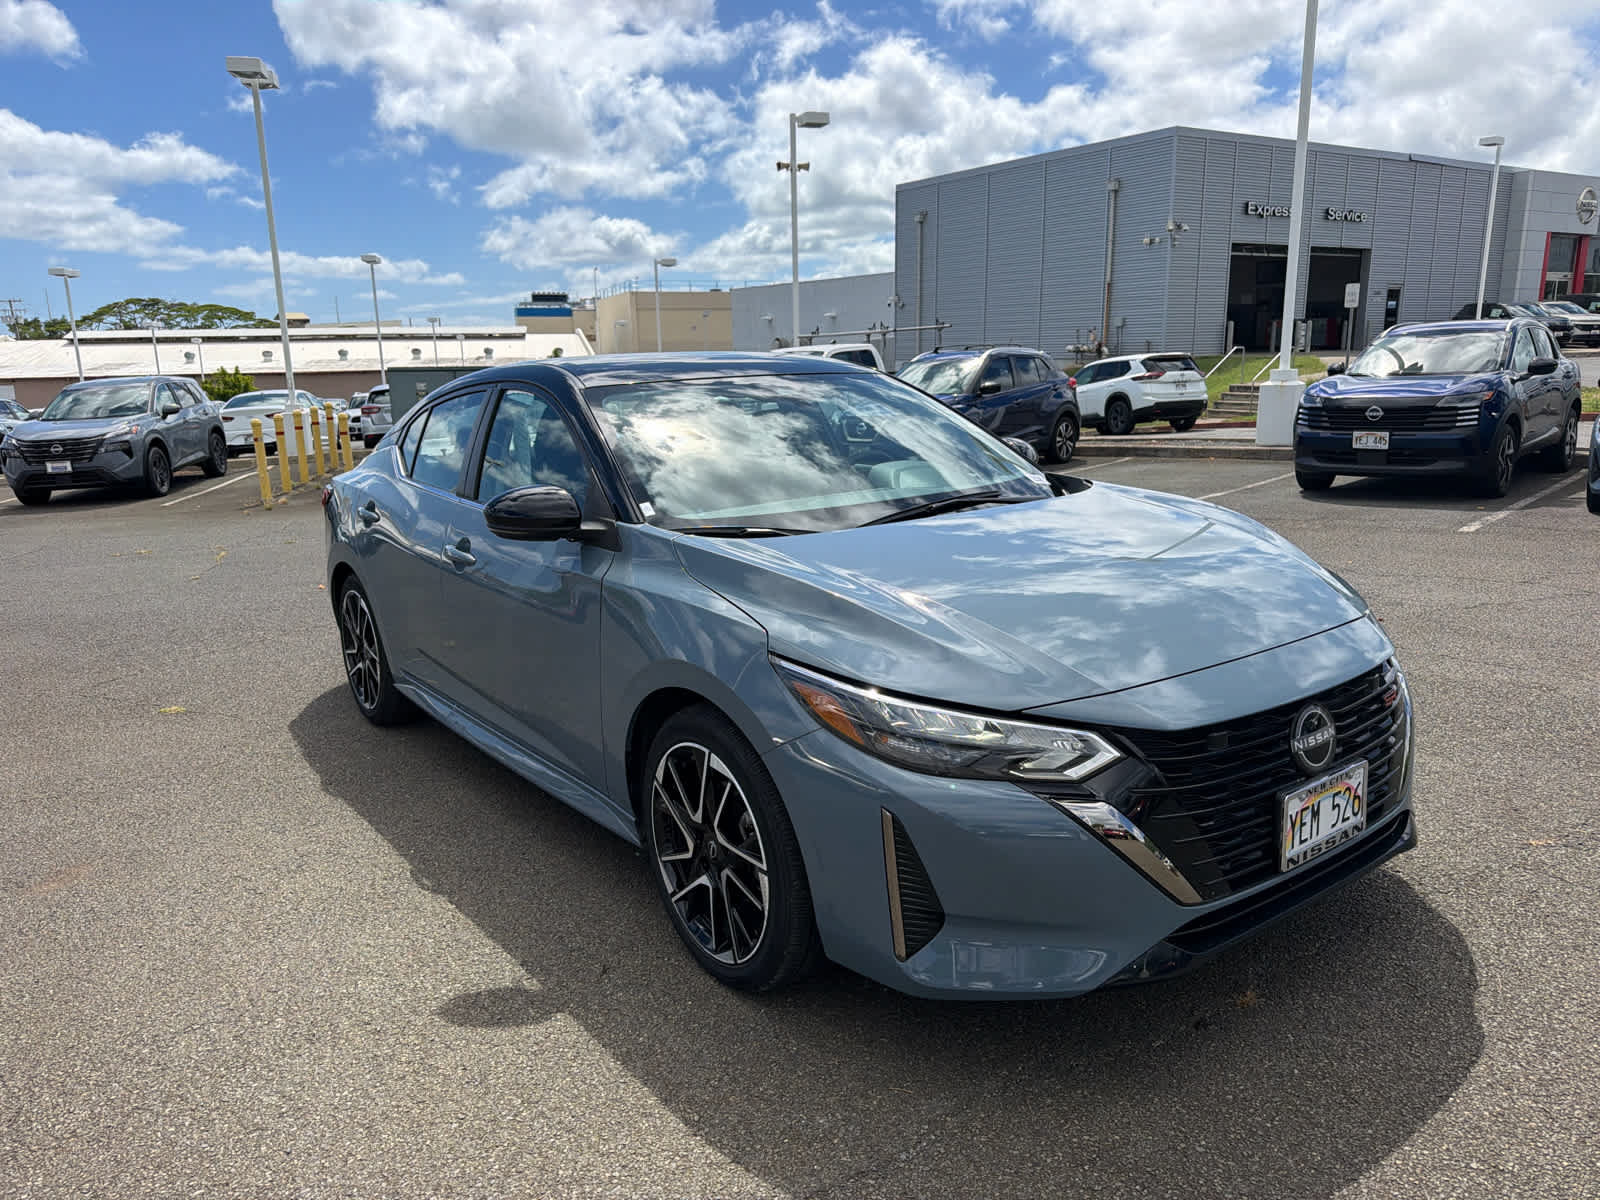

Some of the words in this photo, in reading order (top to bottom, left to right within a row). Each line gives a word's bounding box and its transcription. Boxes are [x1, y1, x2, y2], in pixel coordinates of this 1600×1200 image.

[1327, 207, 1368, 222] Service
[1294, 727, 1335, 751] NISSAN
[1289, 799, 1321, 850] YEM
[1331, 781, 1362, 829] 526
[1286, 821, 1364, 869] NISSAN
